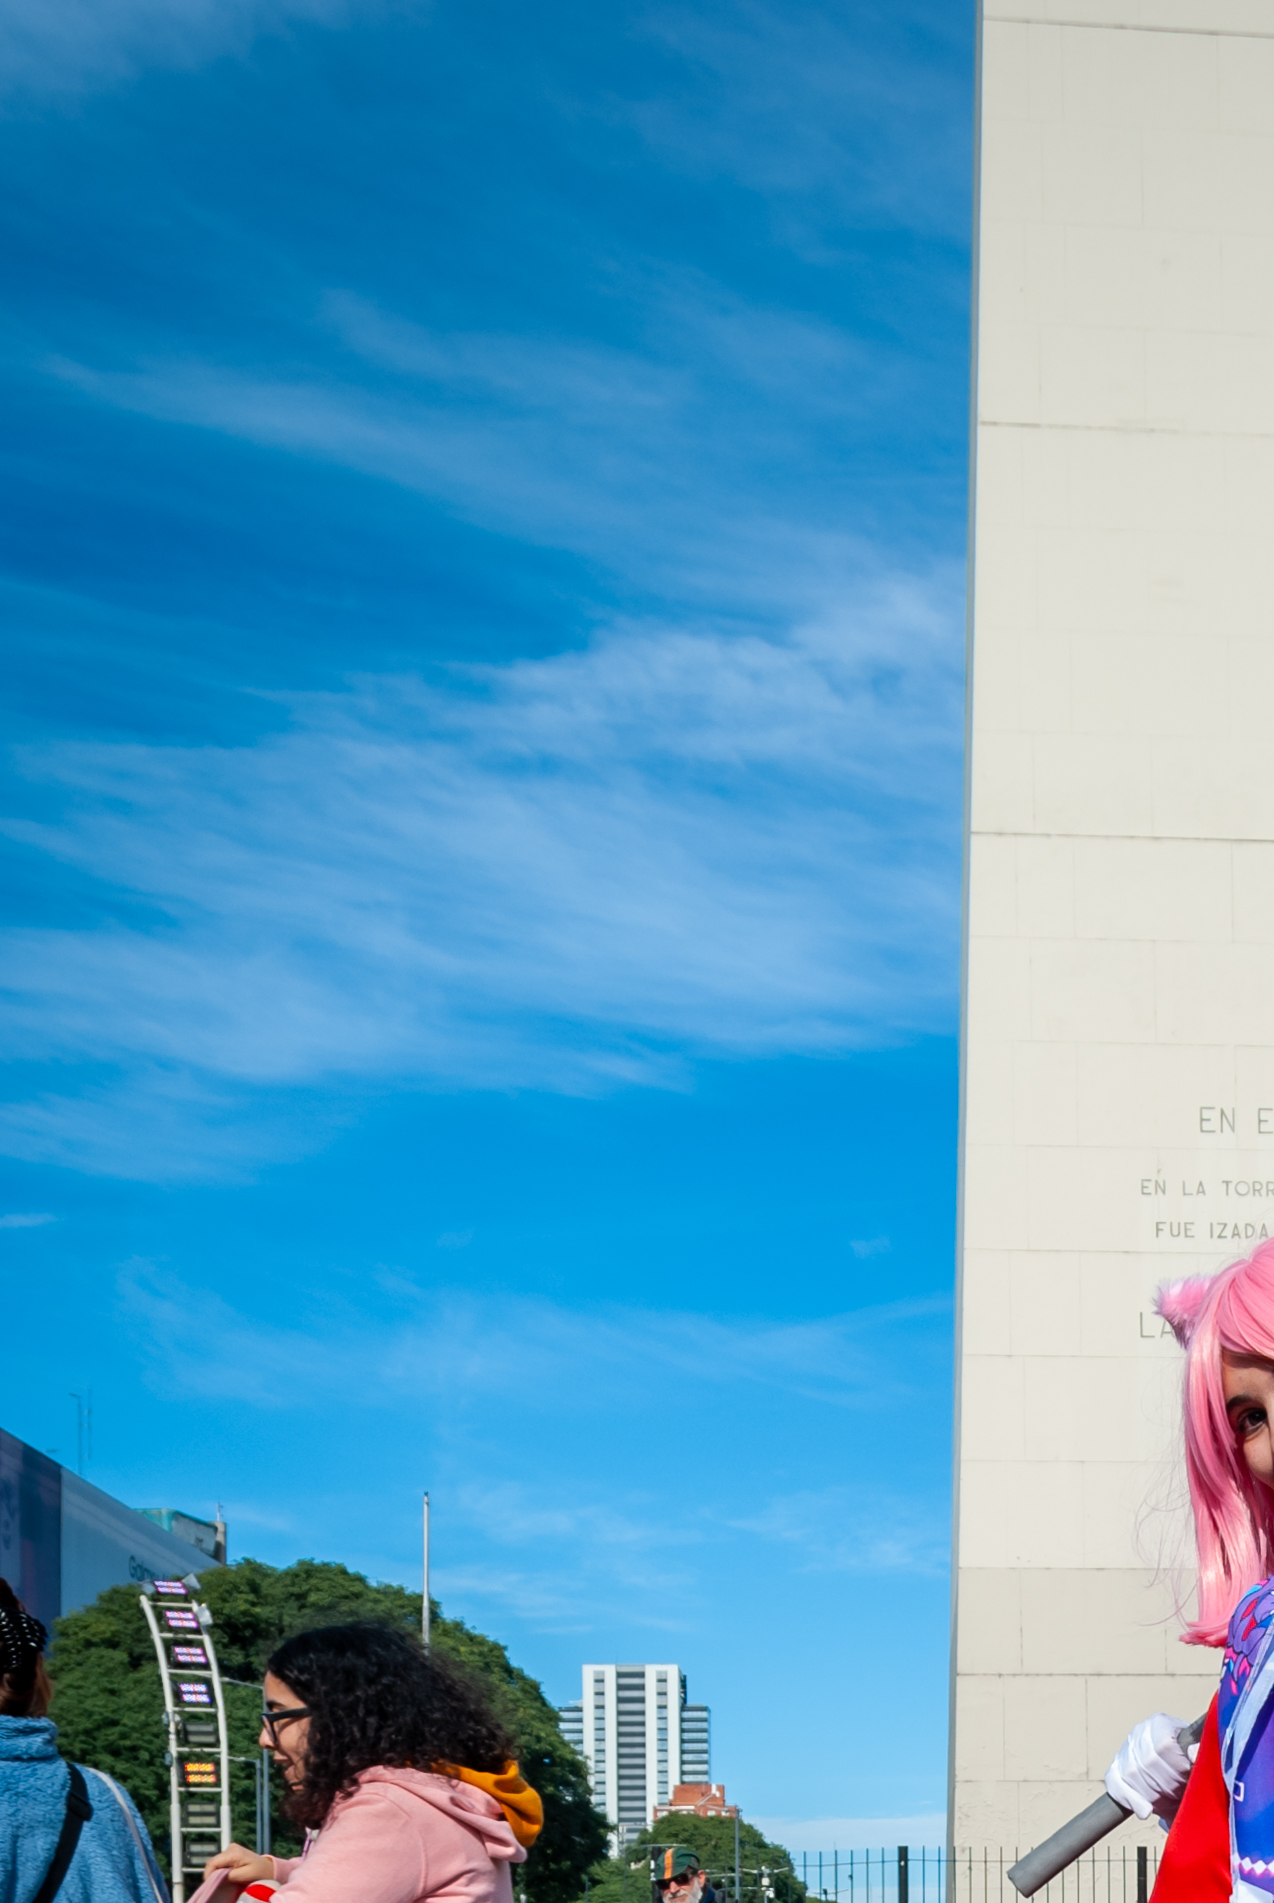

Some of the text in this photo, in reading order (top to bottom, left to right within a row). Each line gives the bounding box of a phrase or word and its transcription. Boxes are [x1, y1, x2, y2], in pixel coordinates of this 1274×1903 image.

[1199, 1106, 1236, 1134] EN
[1140, 1178, 1167, 1196] EN
[1182, 1179, 1207, 1197] LA
[1154, 1221, 1196, 1239] FUE
[1209, 1222, 1270, 1240] IZADA
